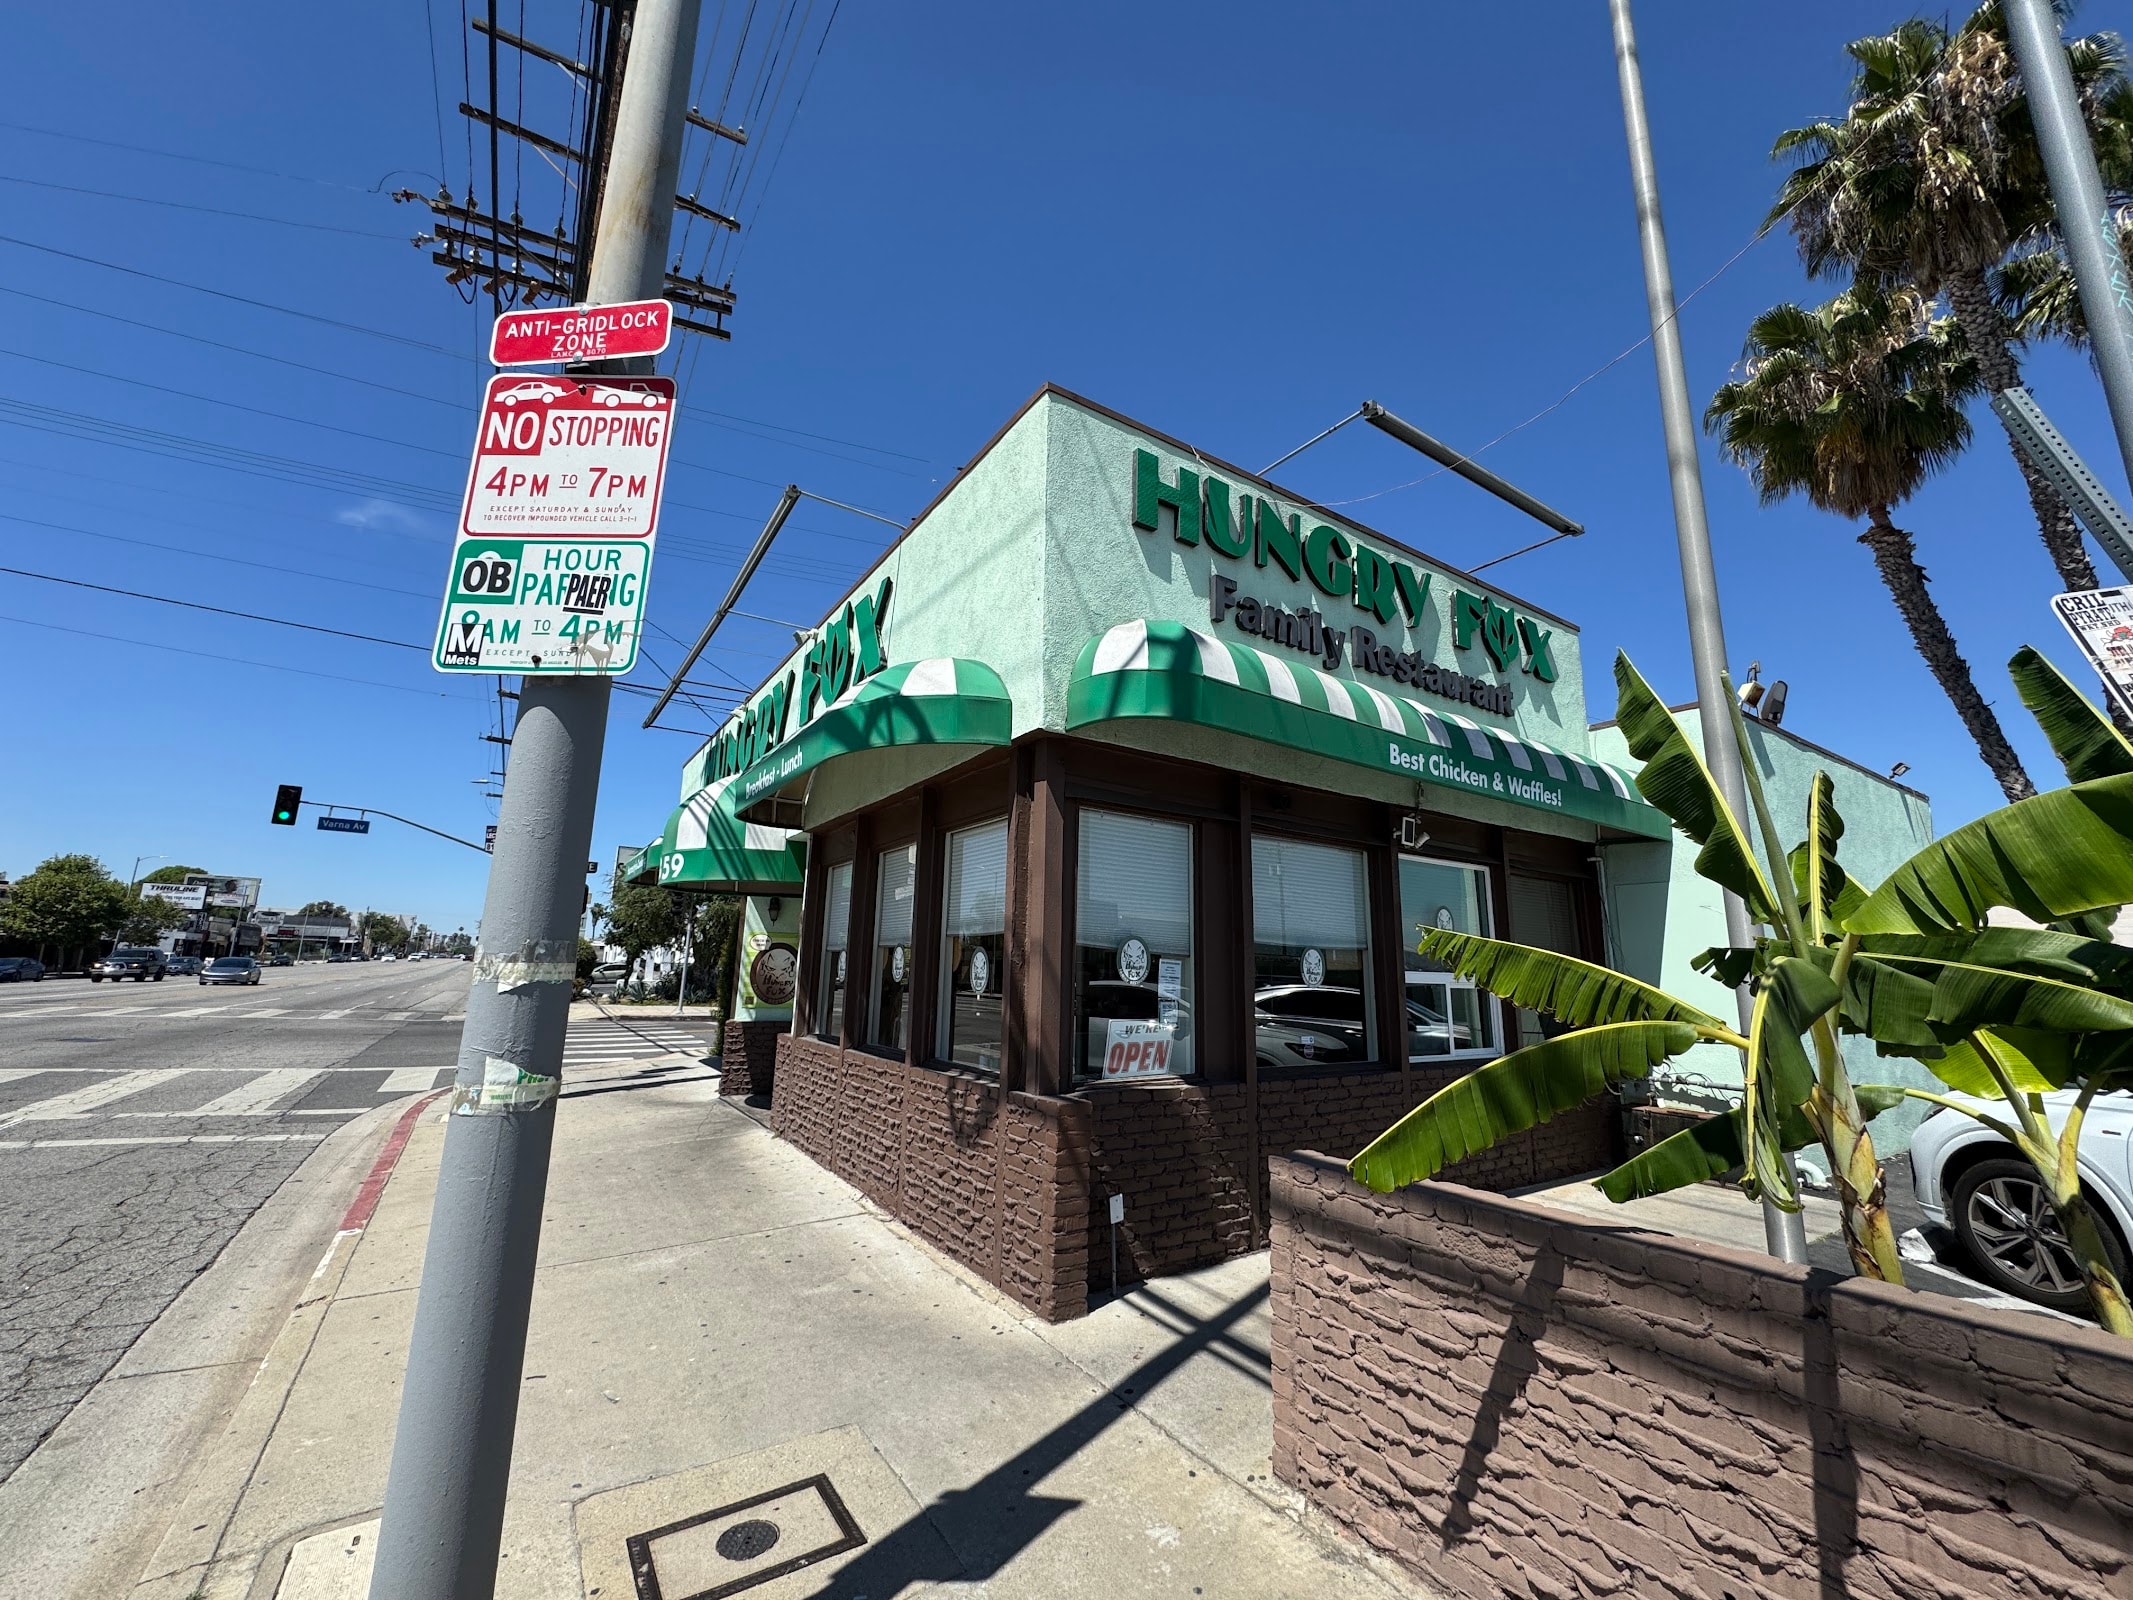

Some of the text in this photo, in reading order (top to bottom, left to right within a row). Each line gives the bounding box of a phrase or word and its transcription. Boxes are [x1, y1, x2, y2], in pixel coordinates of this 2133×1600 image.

[505, 311, 658, 338] ANTI-GRIDLOCK
[553, 332, 607, 351] ZONE
[485, 411, 660, 450] NO STOPPING
[485, 466, 647, 498] 4PM TO 7PM
[544, 549, 622, 571] HOUR
[1132, 448, 1557, 683] HUNGRY FOX
[462, 560, 512, 593] OB
[564, 574, 612, 609] PAER
[2061, 593, 2106, 612] CRIL
[535, 620, 551, 631] TO
[2069, 607, 2116, 626] PYRATE
[486, 649, 530, 658] EXCEPT
[799, 576, 893, 727] FOX
[1210, 574, 1514, 716] Family Restaurant
[444, 654, 477, 666] Mets
[746, 767, 775, 799] Breakfast
[781, 745, 802, 777] Lunch
[1389, 743, 1562, 807] Best Chicken & Waffles!
[322, 819, 365, 831] Varna Av
[660, 853, 684, 880] 59
[1125, 1025, 1158, 1034] WE'RE
[1107, 1040, 1170, 1074] OPEN
